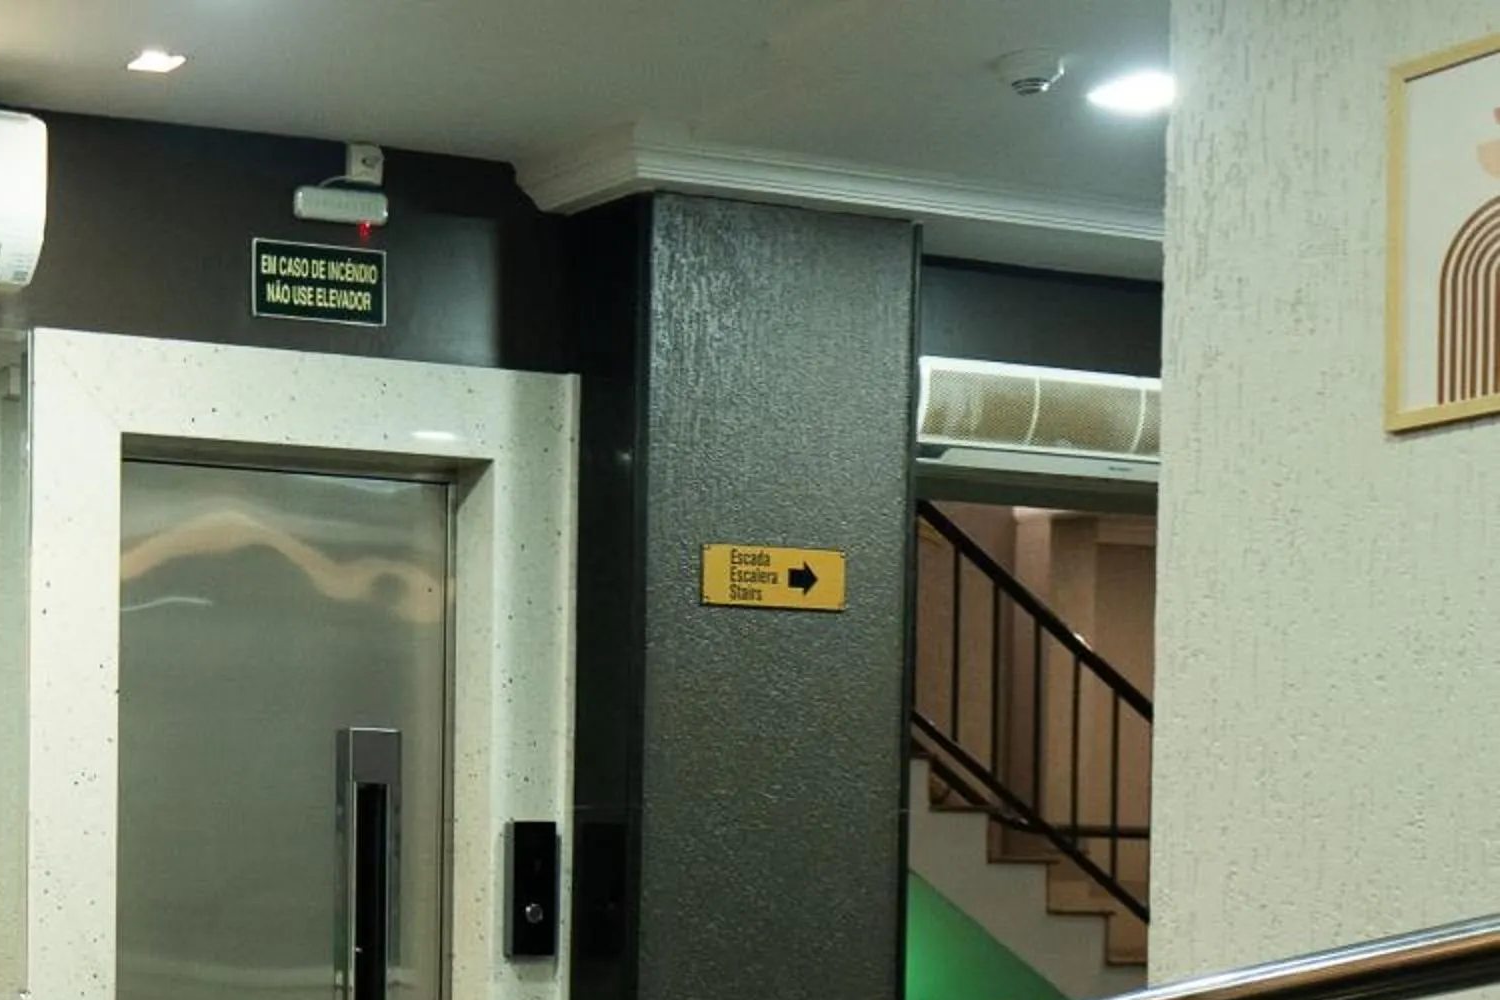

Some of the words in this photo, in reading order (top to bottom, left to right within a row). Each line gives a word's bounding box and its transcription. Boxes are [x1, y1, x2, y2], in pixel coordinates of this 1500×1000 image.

[261, 254, 277, 275] EM
[280, 255, 309, 278] CASO
[312, 259, 326, 279] DE
[328, 257, 378, 284] INCÊNDIO
[266, 280, 290, 304] NÃO
[292, 285, 314, 307] USE
[316, 287, 371, 311] ELEVADOR
[730, 548, 771, 567] Escada
[729, 566, 778, 584] Escalera
[728, 584, 762, 601] Stairs
